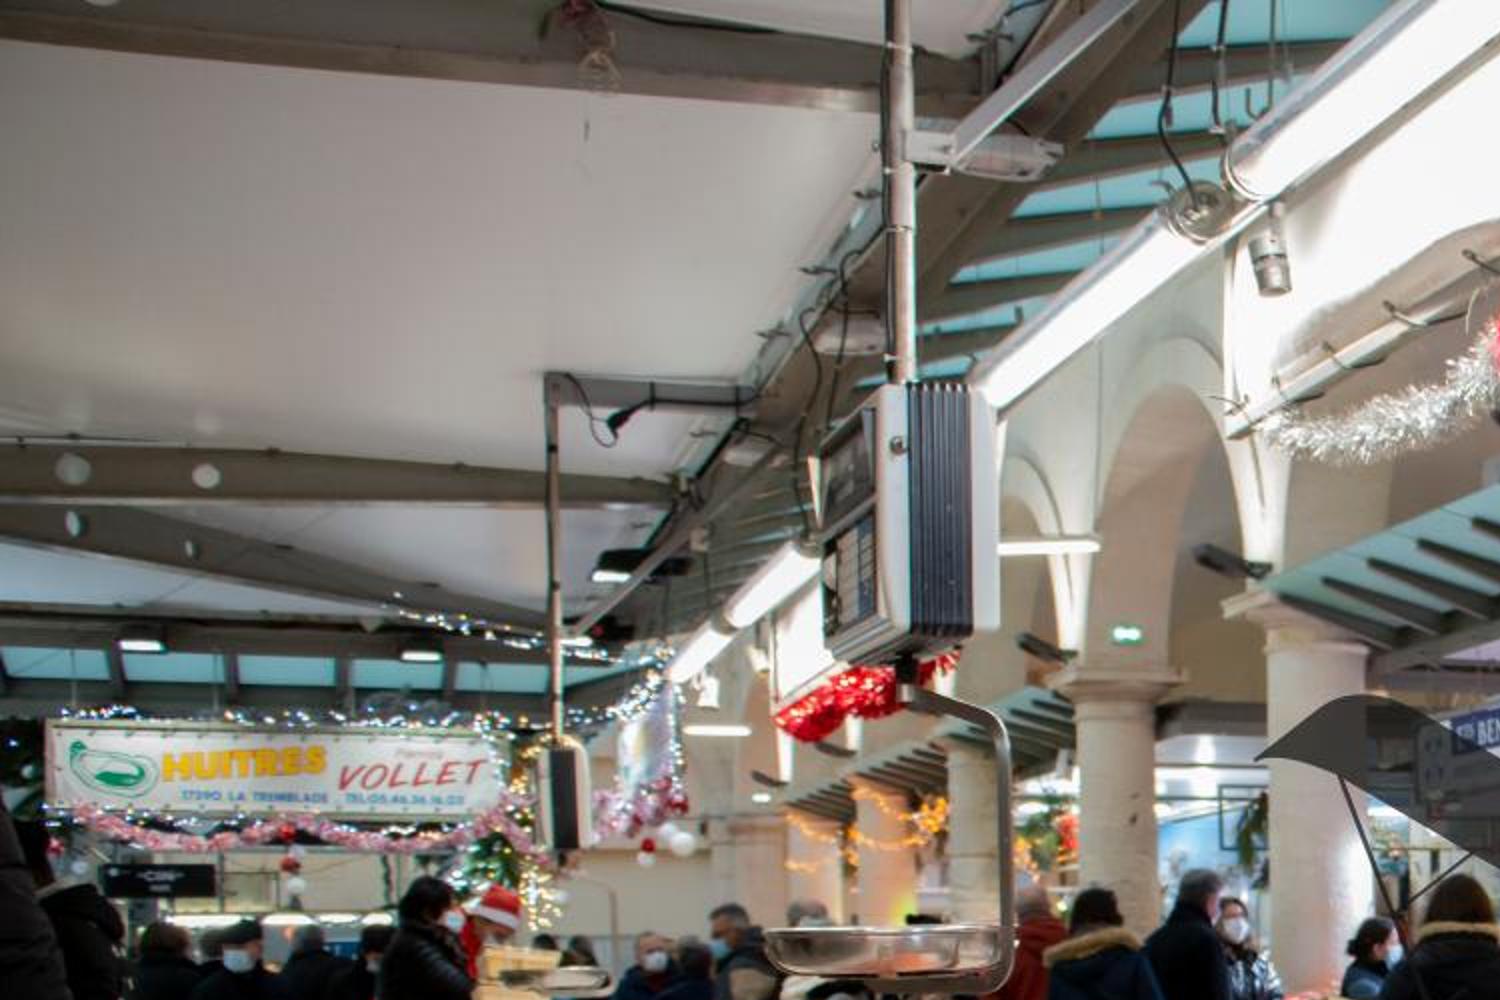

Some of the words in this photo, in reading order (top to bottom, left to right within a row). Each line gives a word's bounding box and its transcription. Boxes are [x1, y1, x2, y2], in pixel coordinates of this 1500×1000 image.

[162, 744, 328, 782] HUITRES
[337, 758, 488, 791] VOLLET
[228, 789, 246, 802] LA
[253, 789, 329, 804] TREMBLADE
